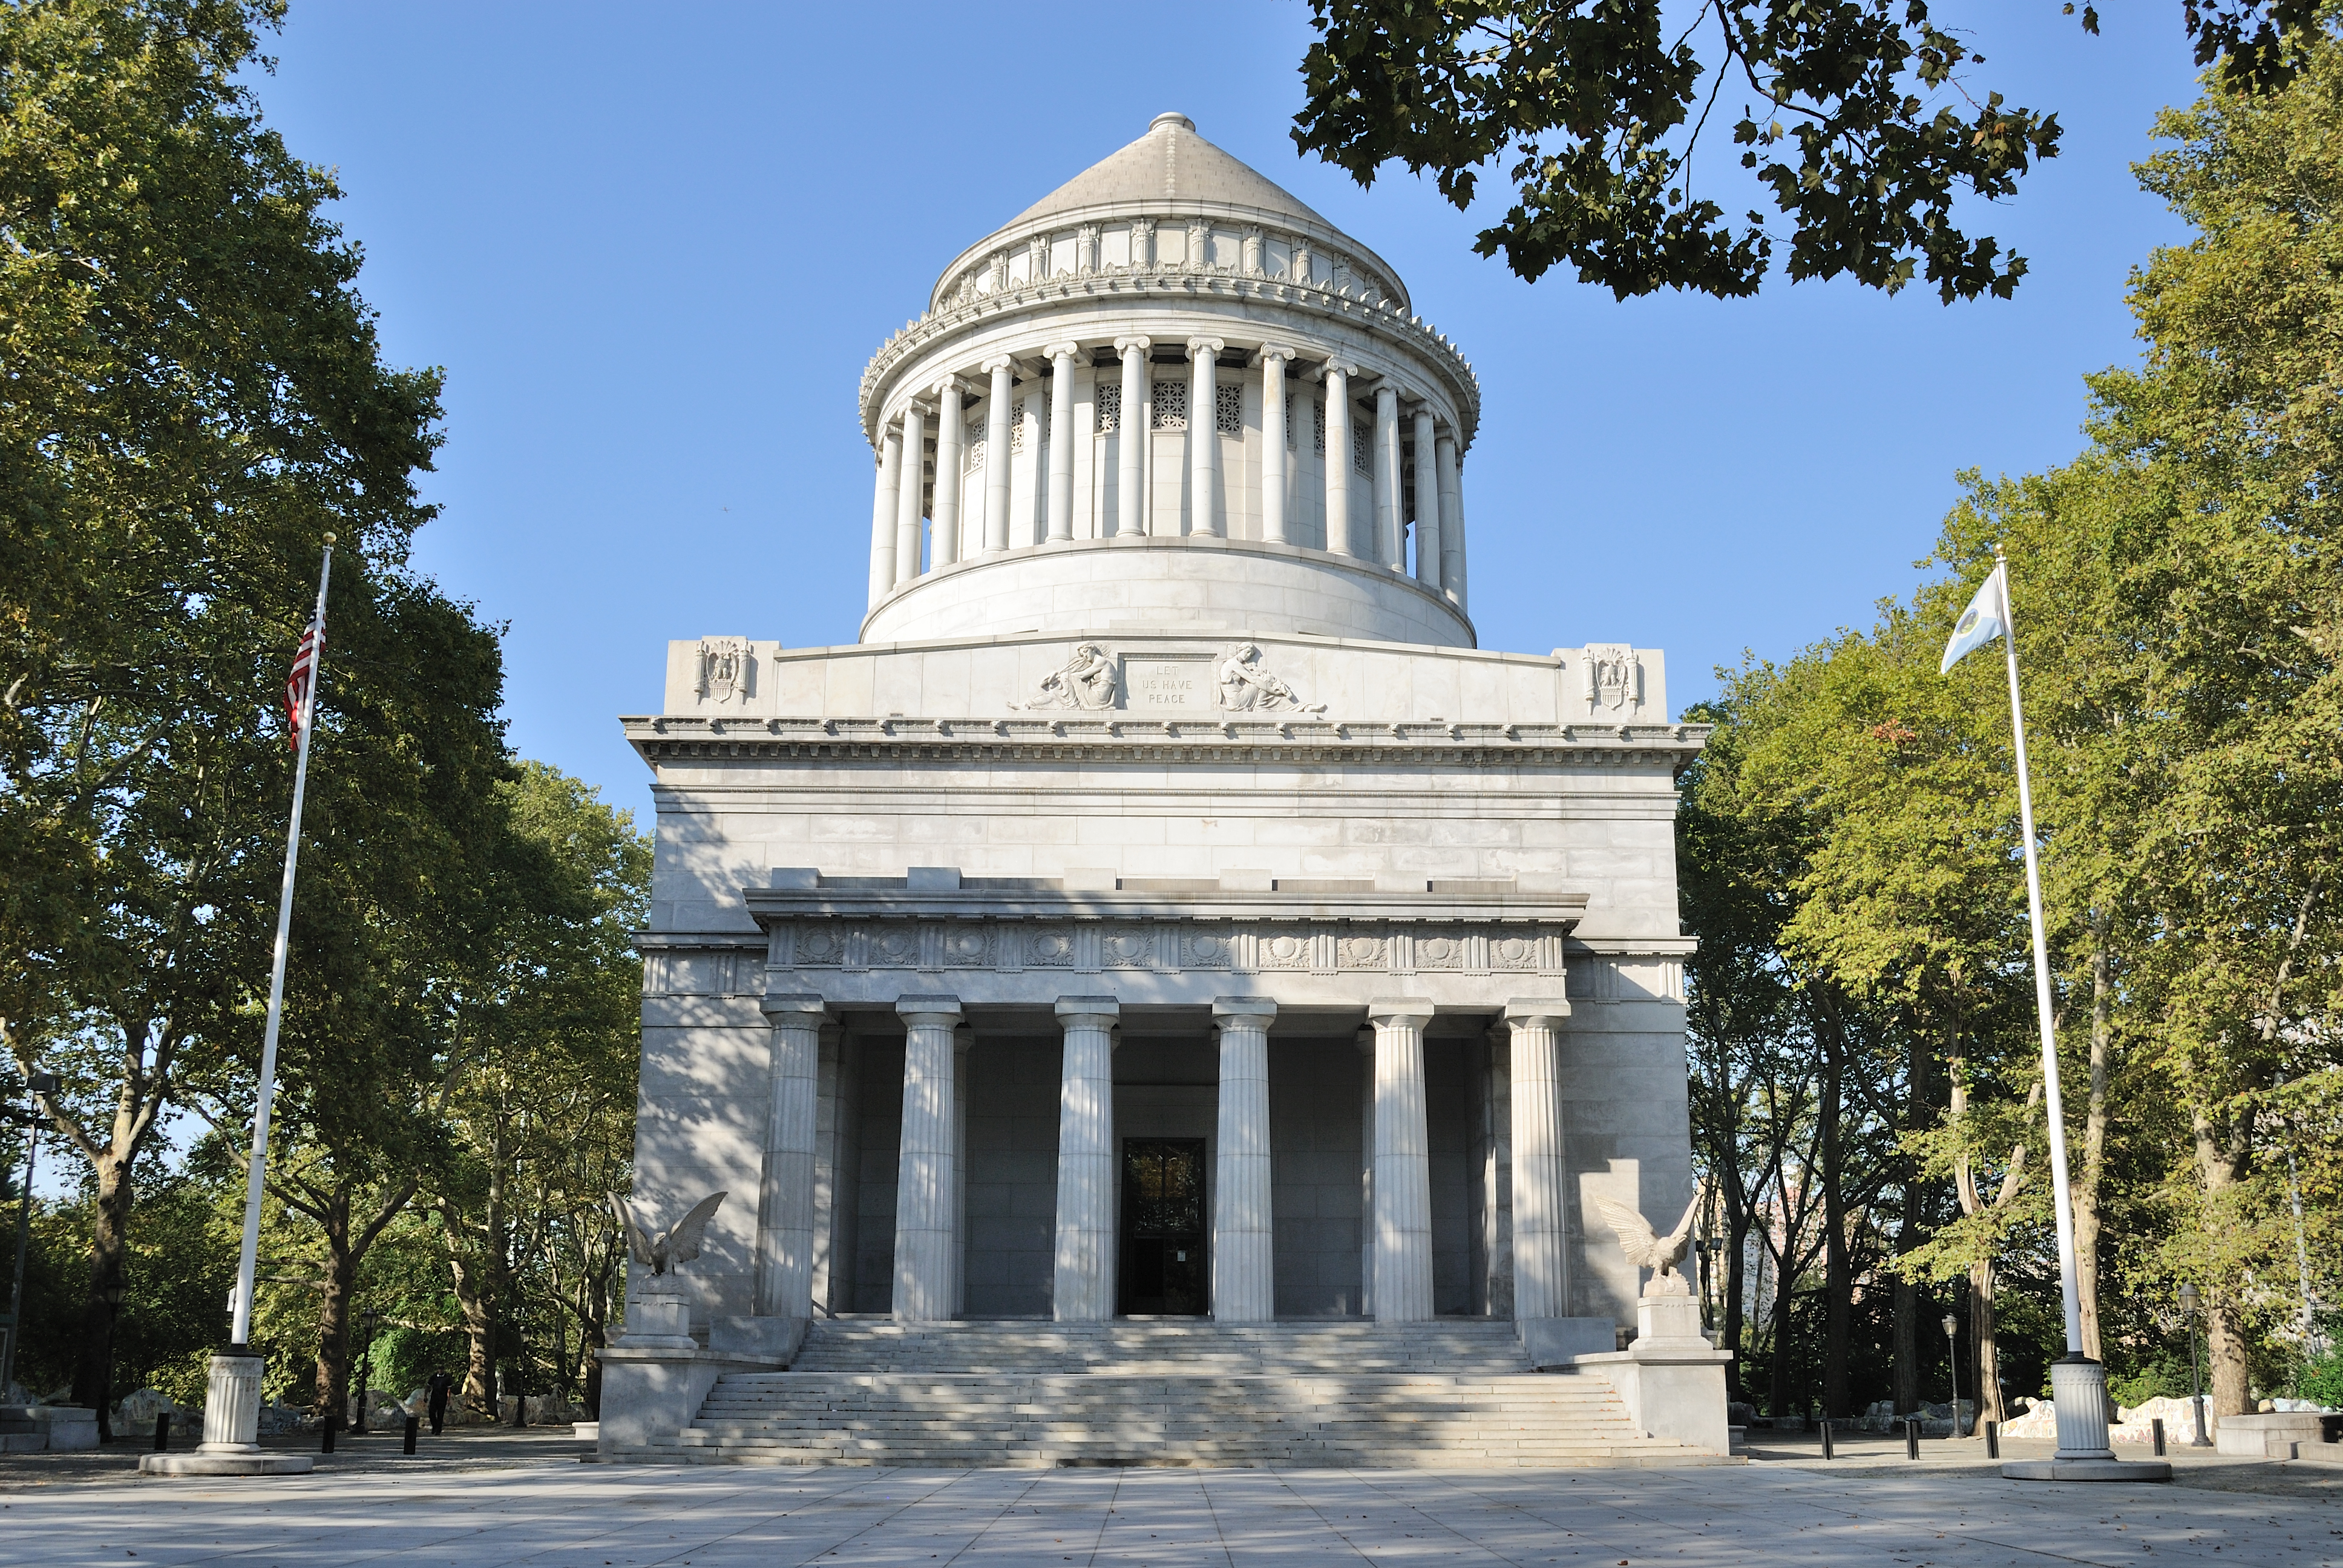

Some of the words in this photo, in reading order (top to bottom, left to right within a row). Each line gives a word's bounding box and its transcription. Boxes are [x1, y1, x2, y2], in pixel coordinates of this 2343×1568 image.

[1157, 666, 1179, 675] LET
[1142, 680, 1156, 689] US
[1162, 680, 1192, 689] HAVE
[1149, 694, 1185, 704] PEACE
